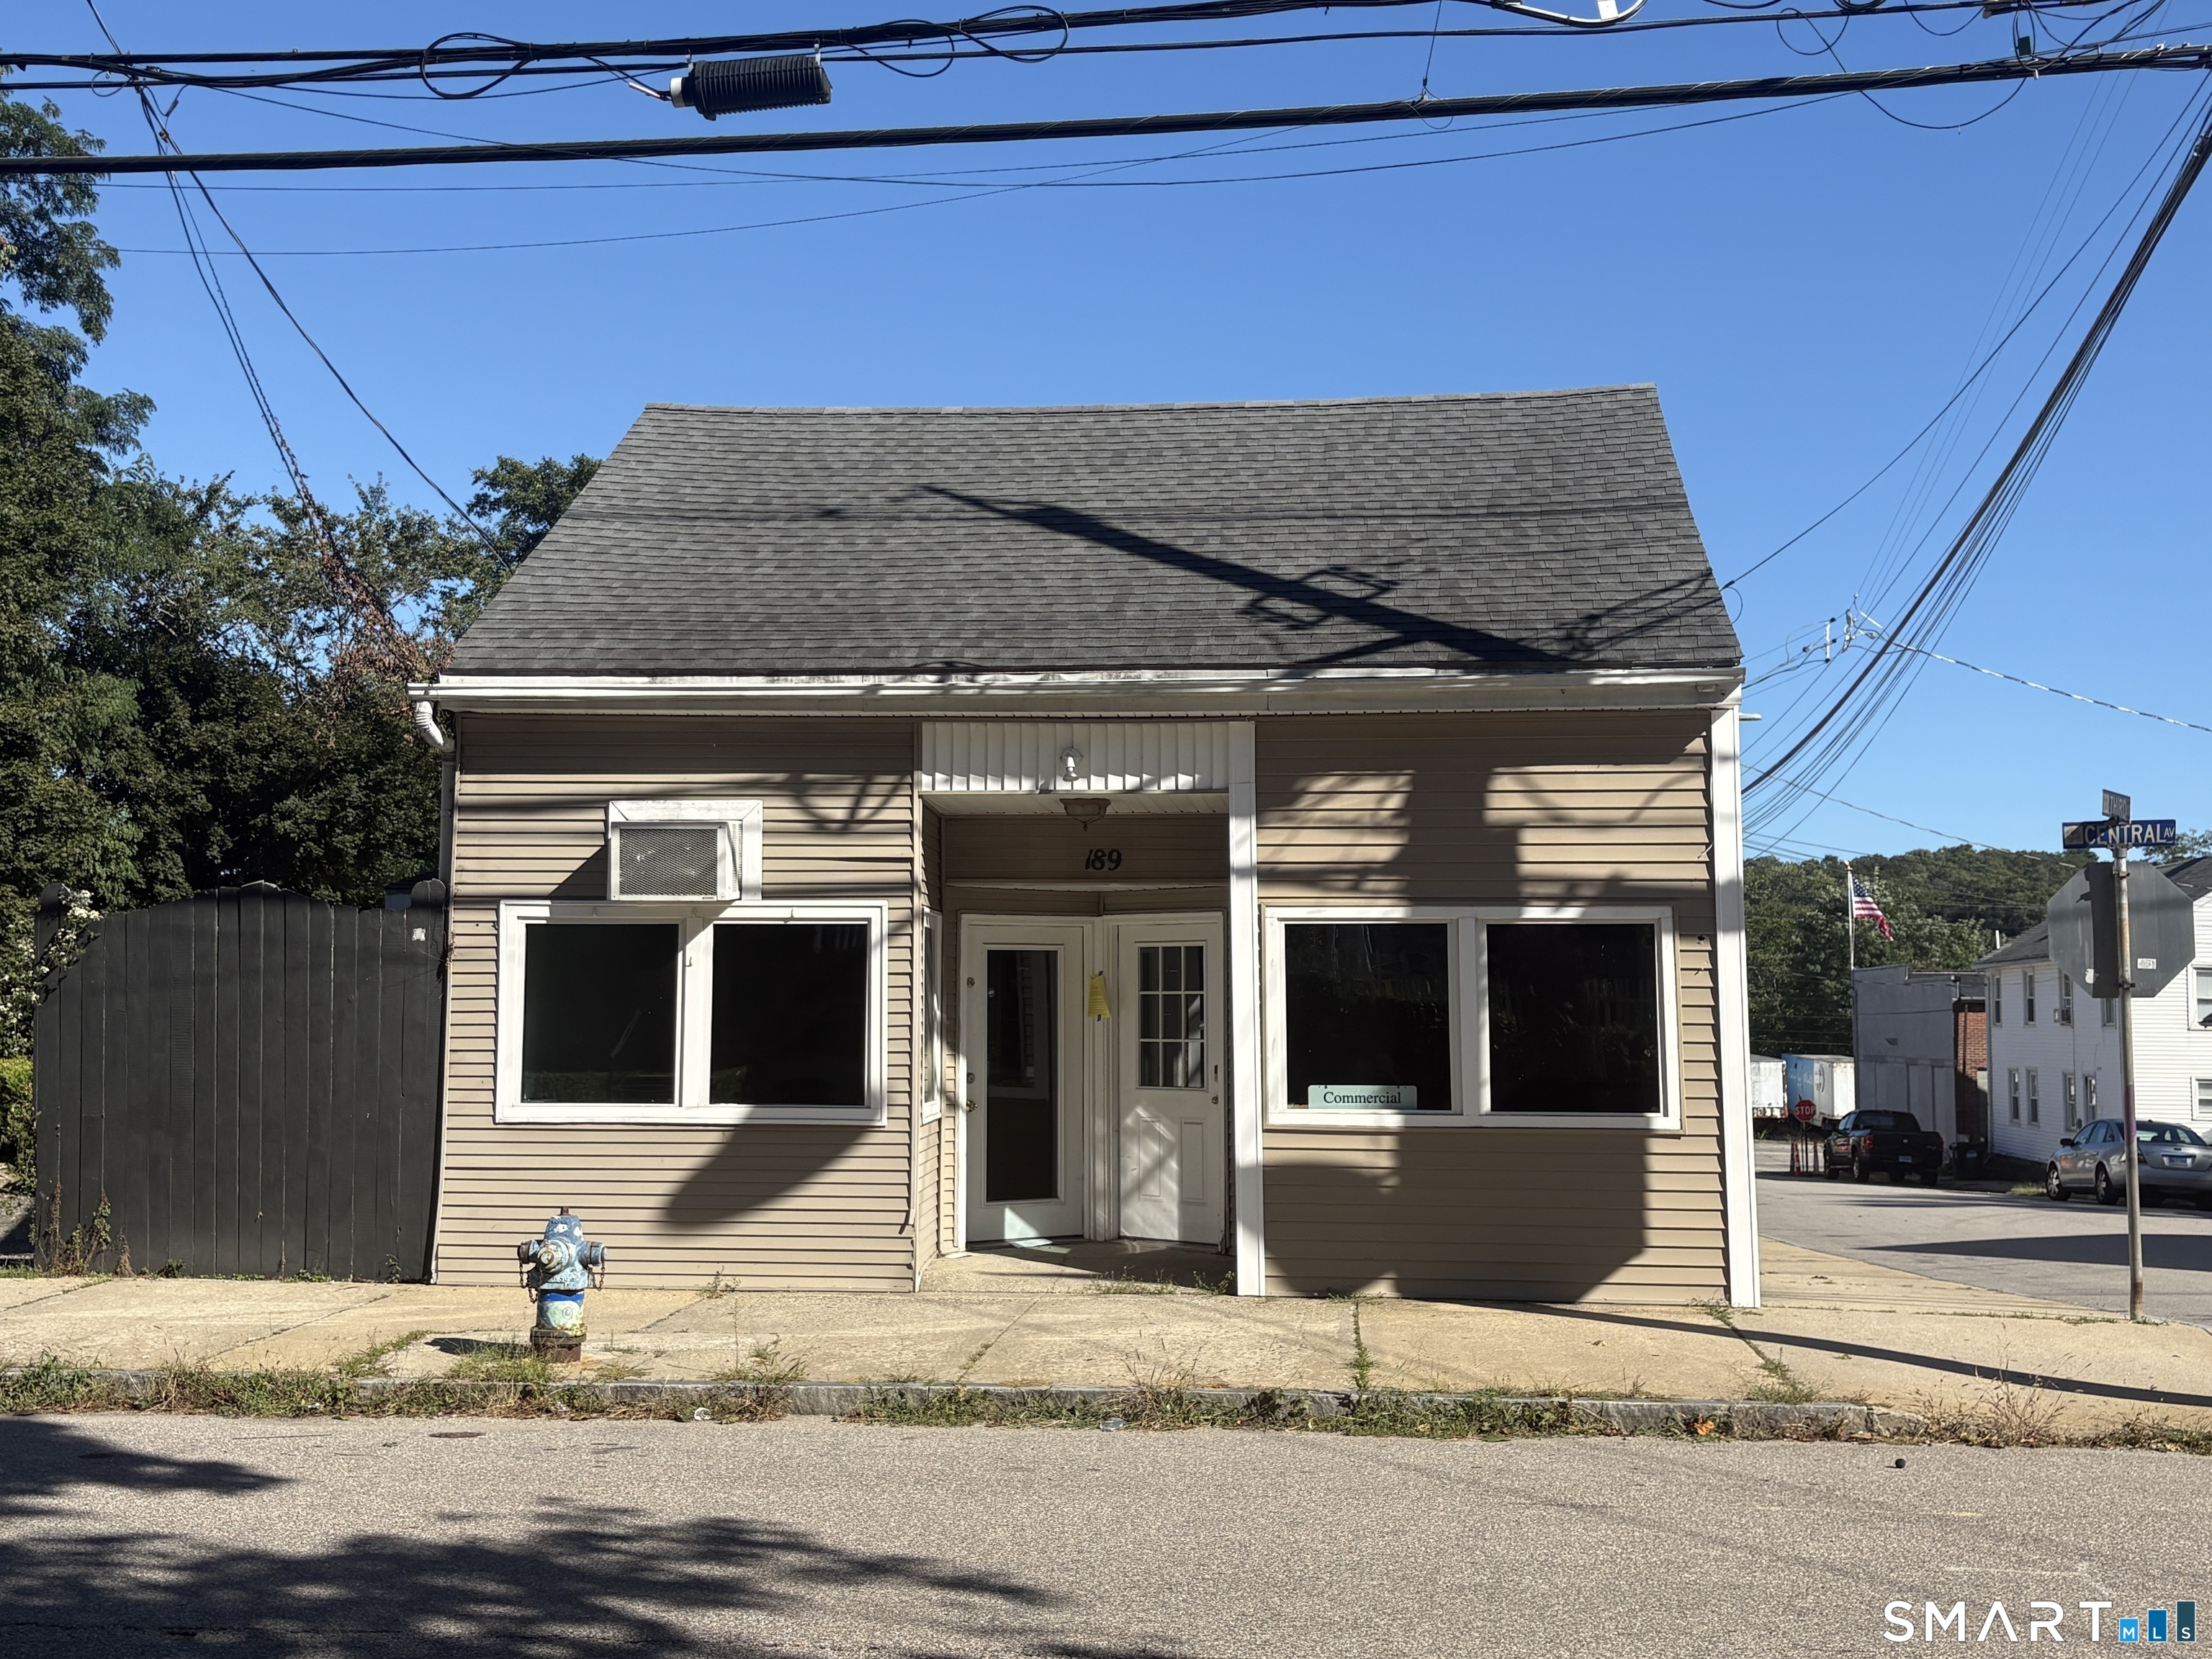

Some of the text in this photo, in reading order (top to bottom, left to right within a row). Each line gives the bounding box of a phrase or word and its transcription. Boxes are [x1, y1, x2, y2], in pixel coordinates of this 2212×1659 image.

[2085, 824, 2175, 845] CENTRAL AV
[1085, 849, 1122, 871] 189
[1323, 1092, 1402, 1104] Commercial
[1795, 1106, 1815, 1115] STOP
